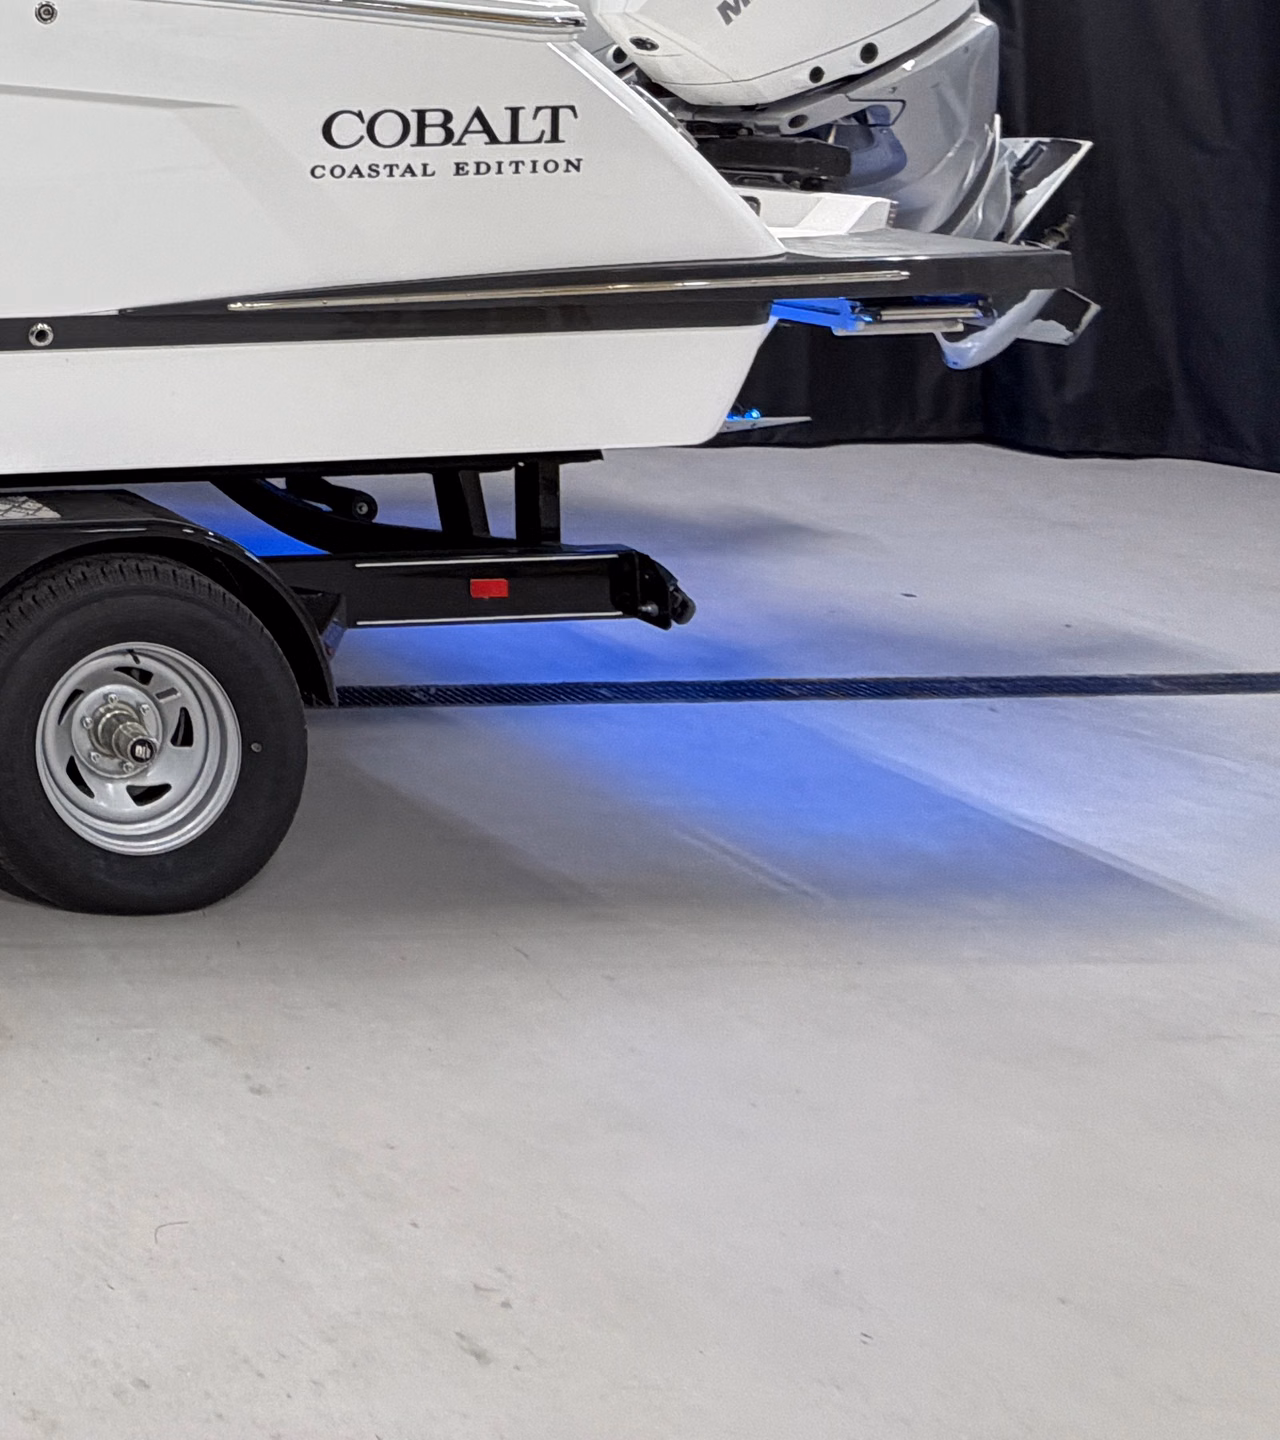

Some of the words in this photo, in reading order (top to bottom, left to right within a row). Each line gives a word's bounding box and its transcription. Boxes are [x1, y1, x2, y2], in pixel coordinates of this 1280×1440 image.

[321, 105, 579, 150] COBALT
[309, 162, 436, 179] COASTAL
[453, 158, 583, 177] EDITION
